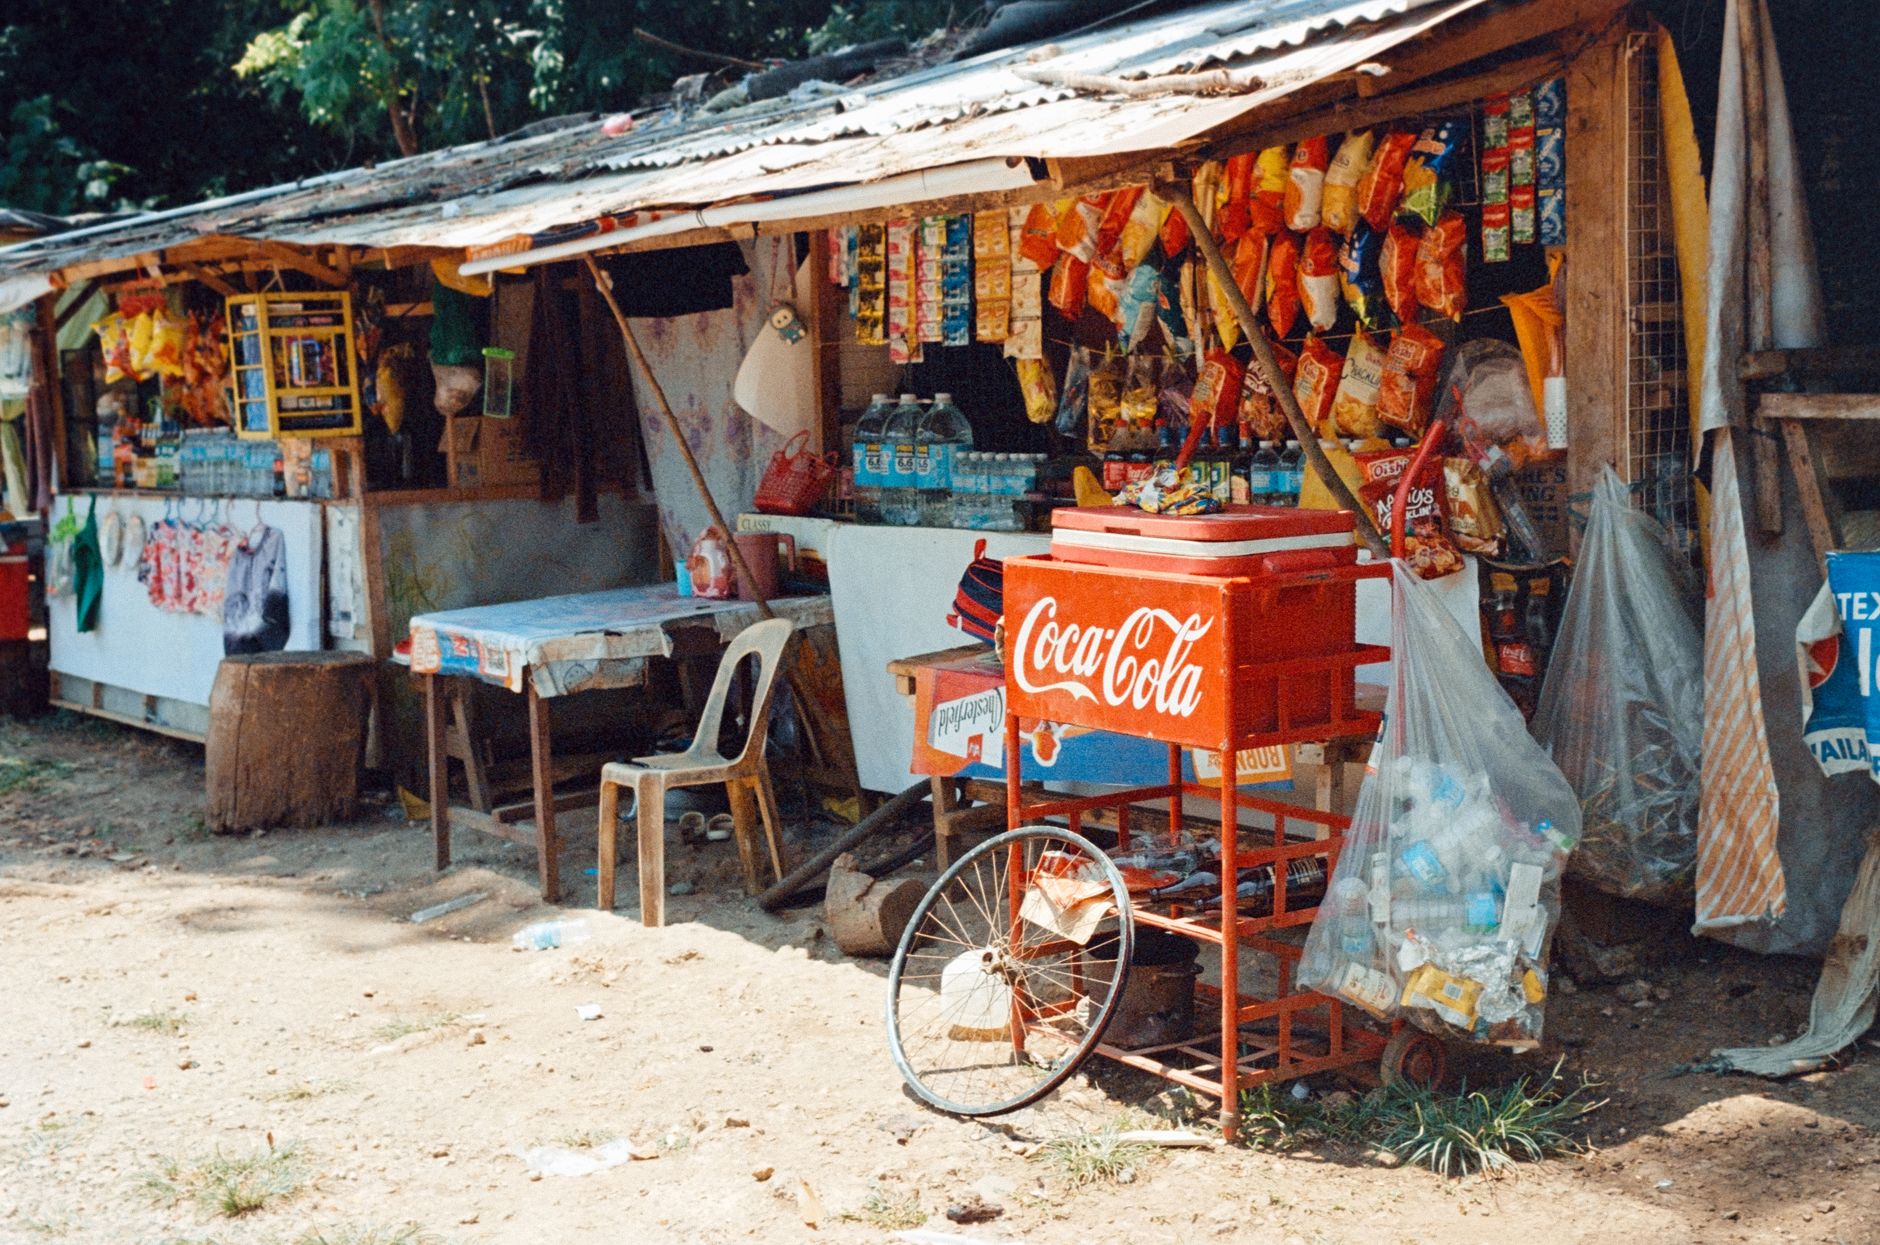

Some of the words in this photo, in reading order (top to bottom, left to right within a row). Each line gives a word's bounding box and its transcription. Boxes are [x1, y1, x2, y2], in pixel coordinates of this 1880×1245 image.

[897, 459, 913, 467] 6.6
[1014, 597, 1214, 717] Coca-Cola
[938, 687, 1003, 737] Chesterfield
